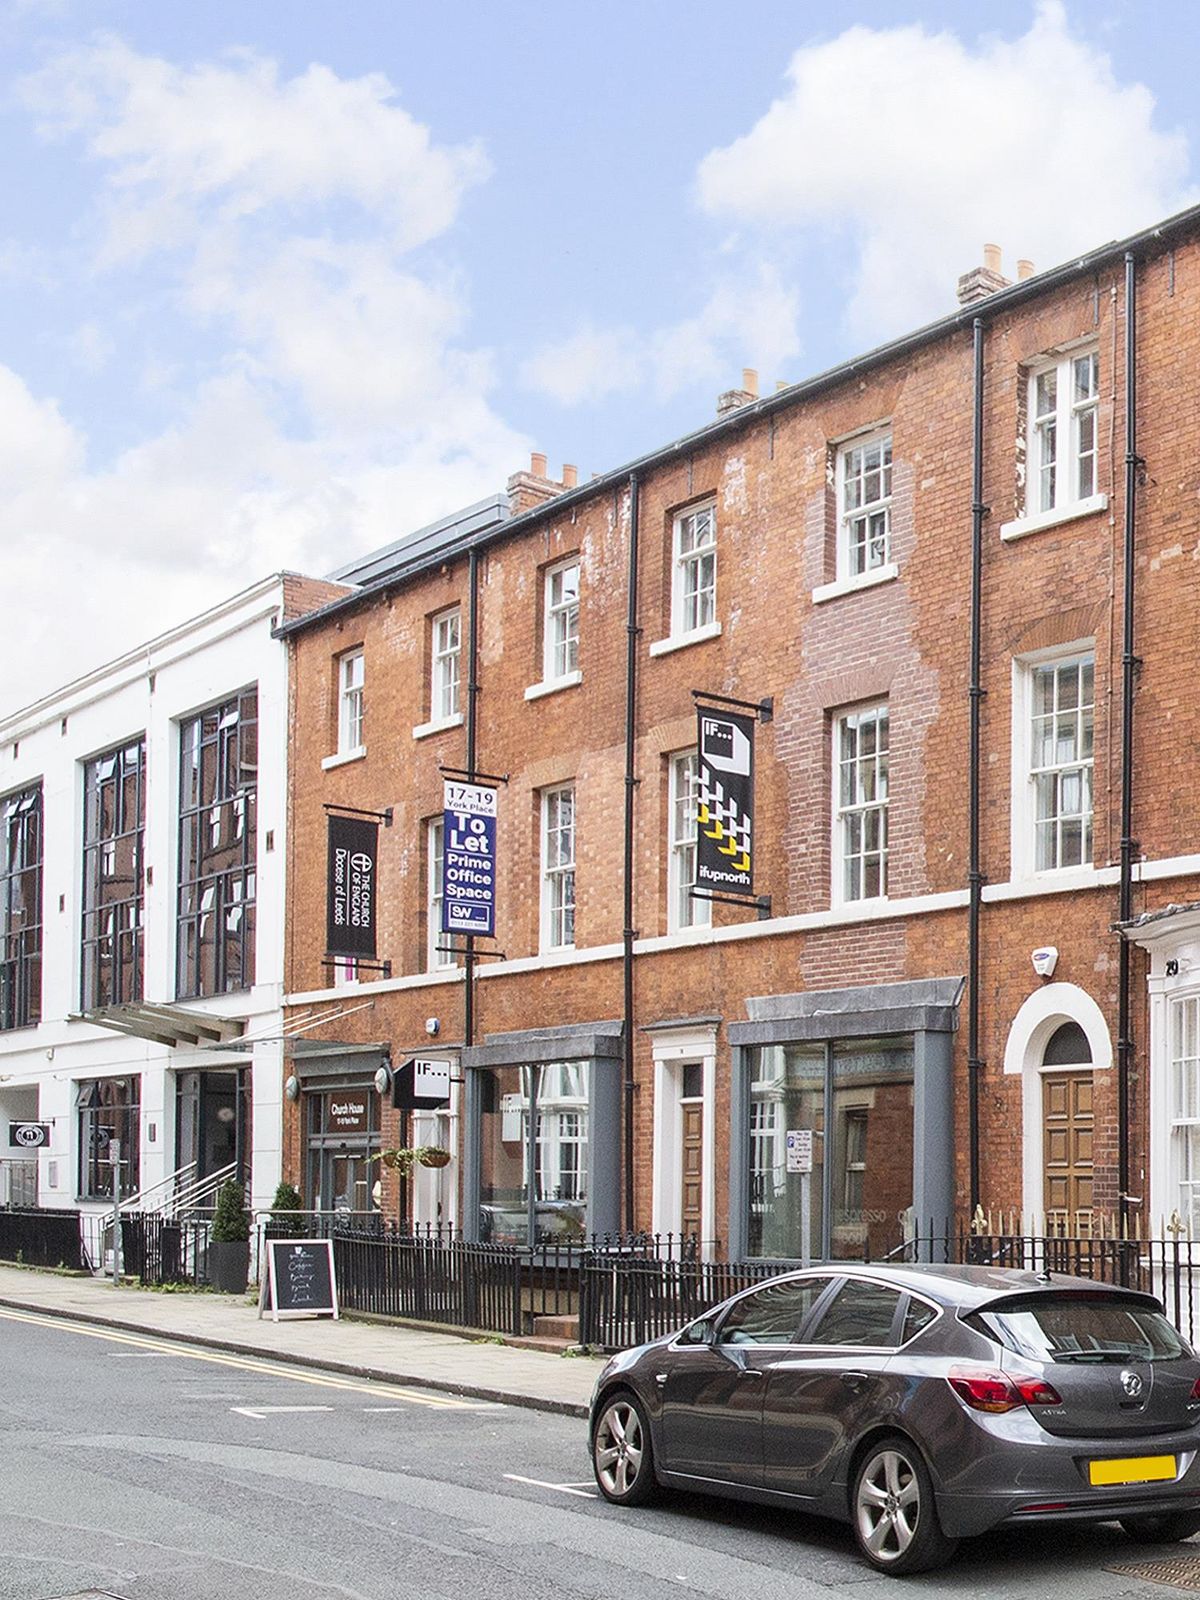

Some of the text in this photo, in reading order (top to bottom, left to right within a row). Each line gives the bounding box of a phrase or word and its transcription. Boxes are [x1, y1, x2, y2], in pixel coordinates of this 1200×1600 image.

[449, 787, 493, 805] 17-19
[447, 799, 494, 814] York Place
[453, 811, 486, 835] To
[450, 829, 489, 853] Let
[447, 853, 492, 870] Prime
[446, 868, 492, 885] Office
[699, 865, 750, 885] ifupnorth
[334, 848, 347, 926] Diocese of Leeds
[446, 883, 492, 900] Space
[351, 872, 361, 926] OF ENGLAND
[361, 874, 370, 928] THE CHURCH
[417, 1062, 447, 1077] IF...
[331, 1102, 364, 1116] Church House
